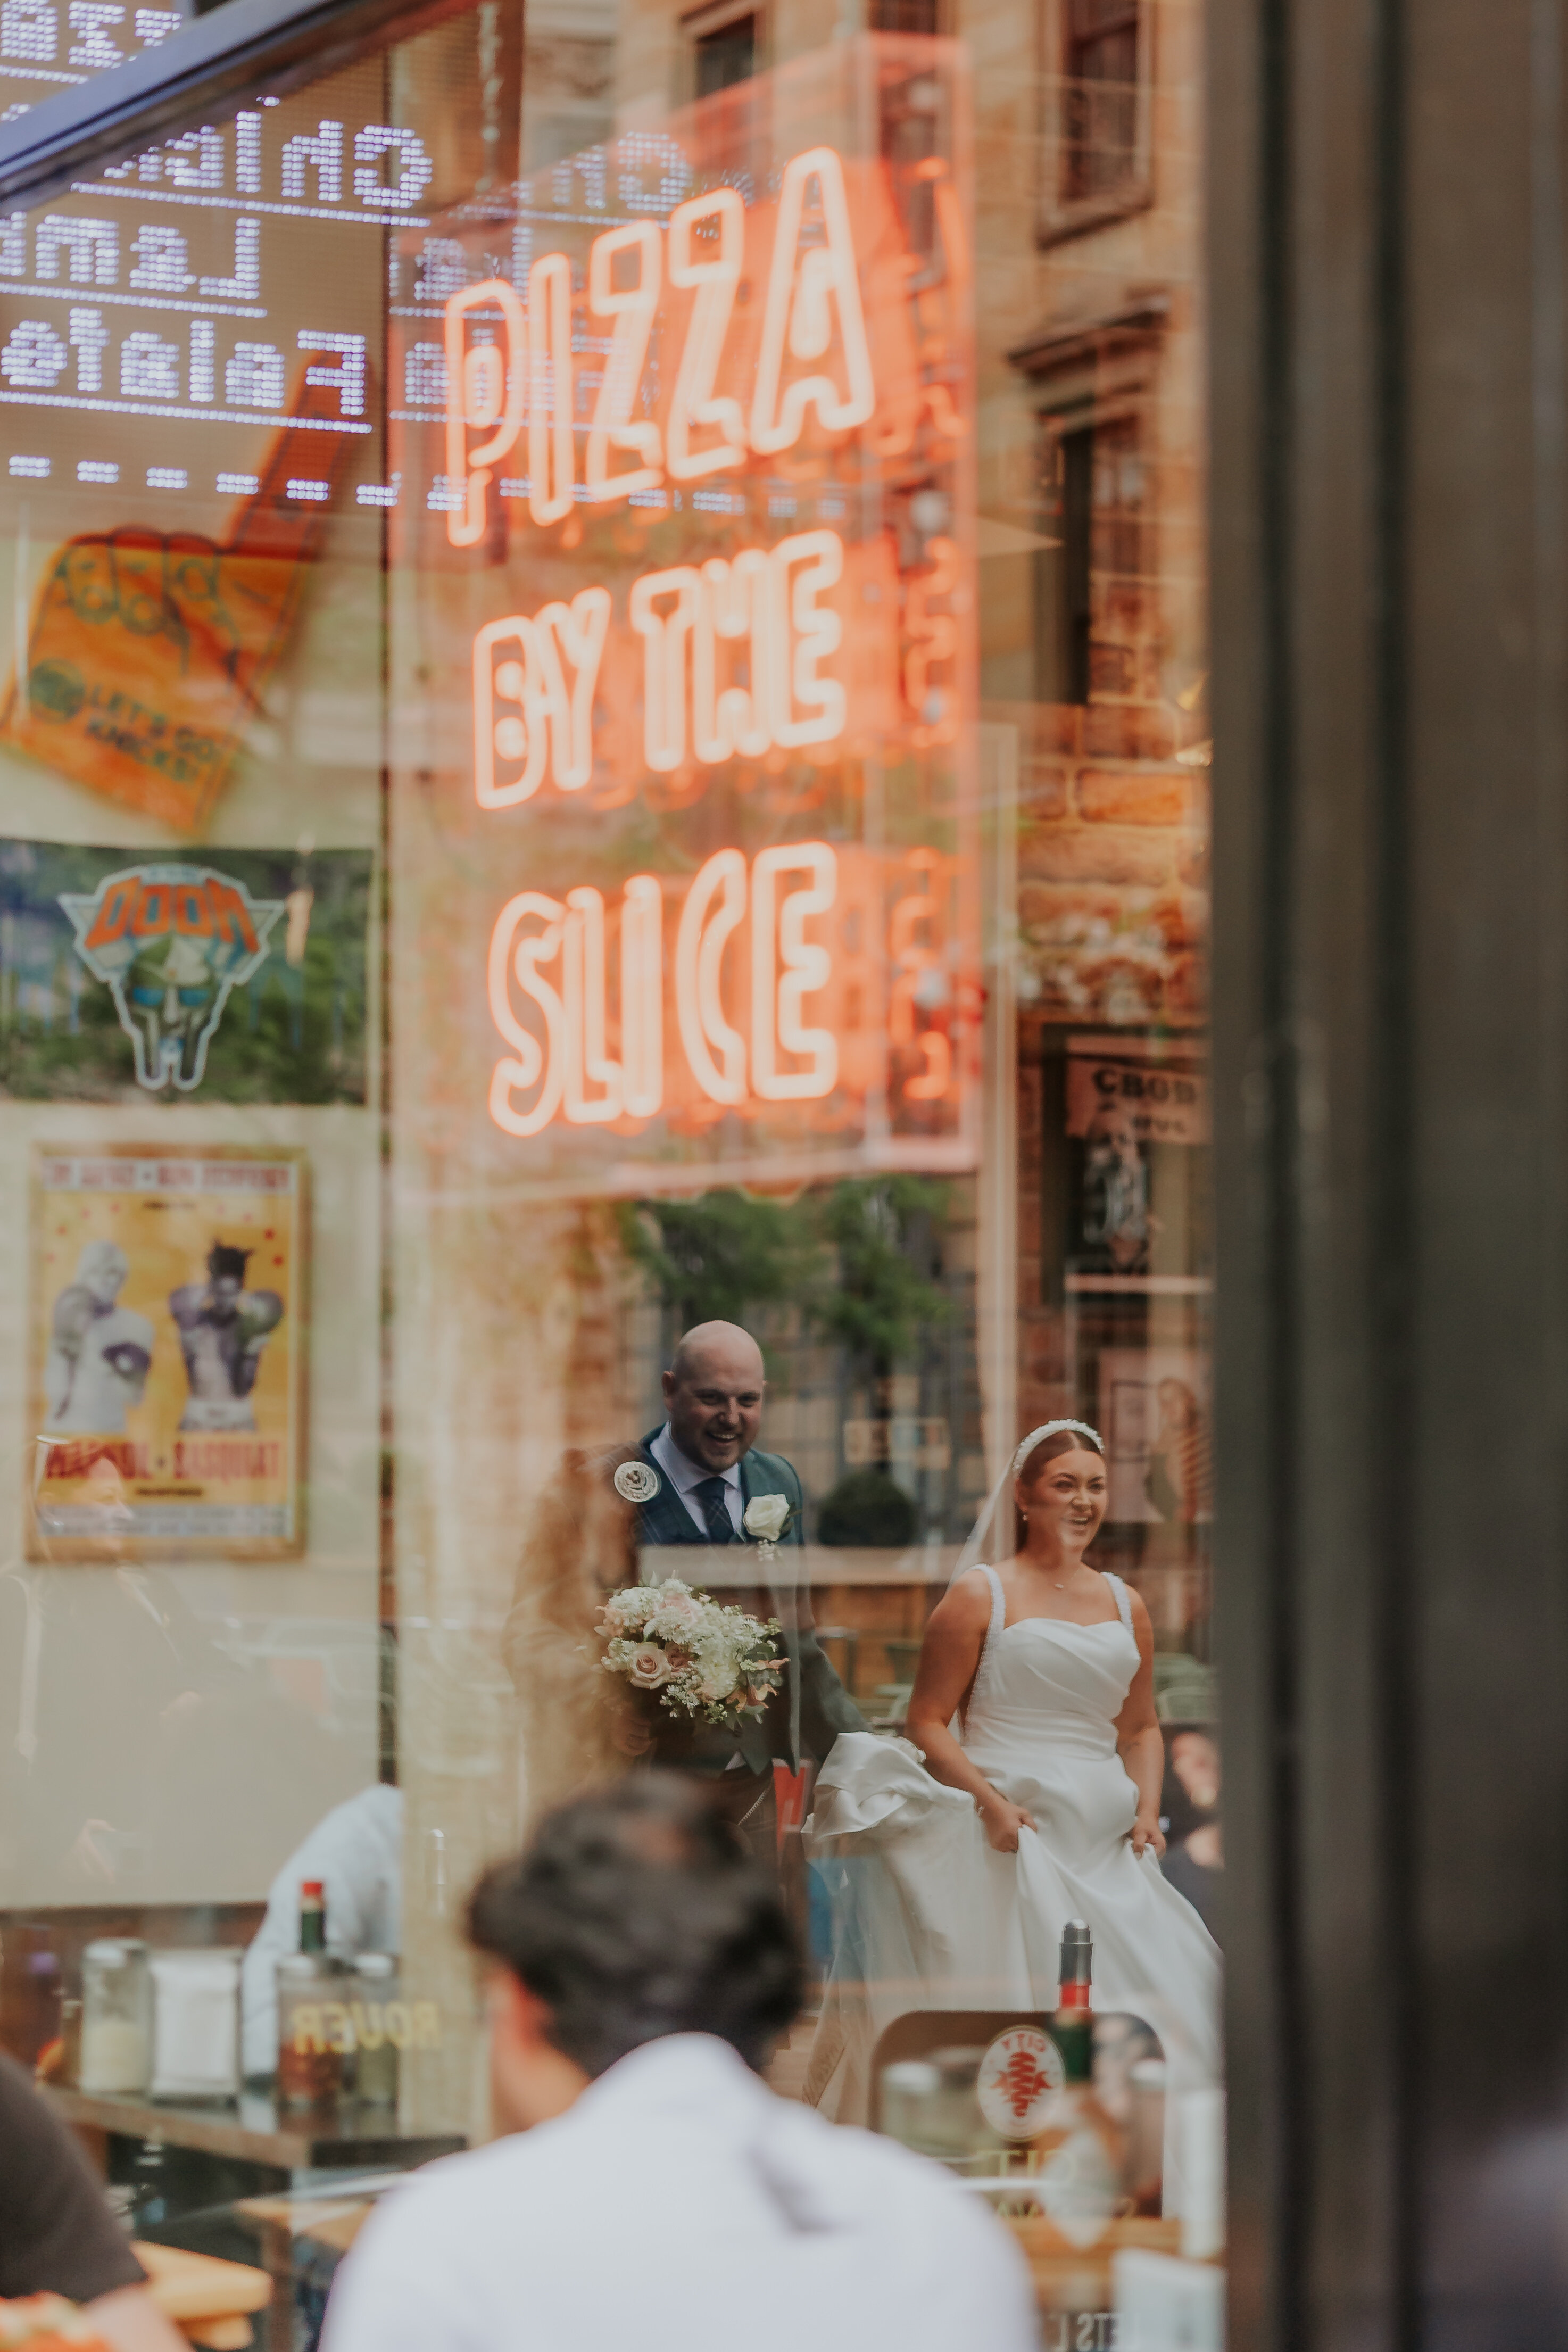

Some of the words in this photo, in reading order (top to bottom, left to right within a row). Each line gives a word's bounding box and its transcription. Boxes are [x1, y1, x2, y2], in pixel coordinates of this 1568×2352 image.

[445, 146, 875, 547] PIZZA
[473, 586, 611, 809] BY
[630, 529, 845, 772] THE
[84, 875, 260, 954] DOOM
[488, 840, 837, 1136] SLICE
